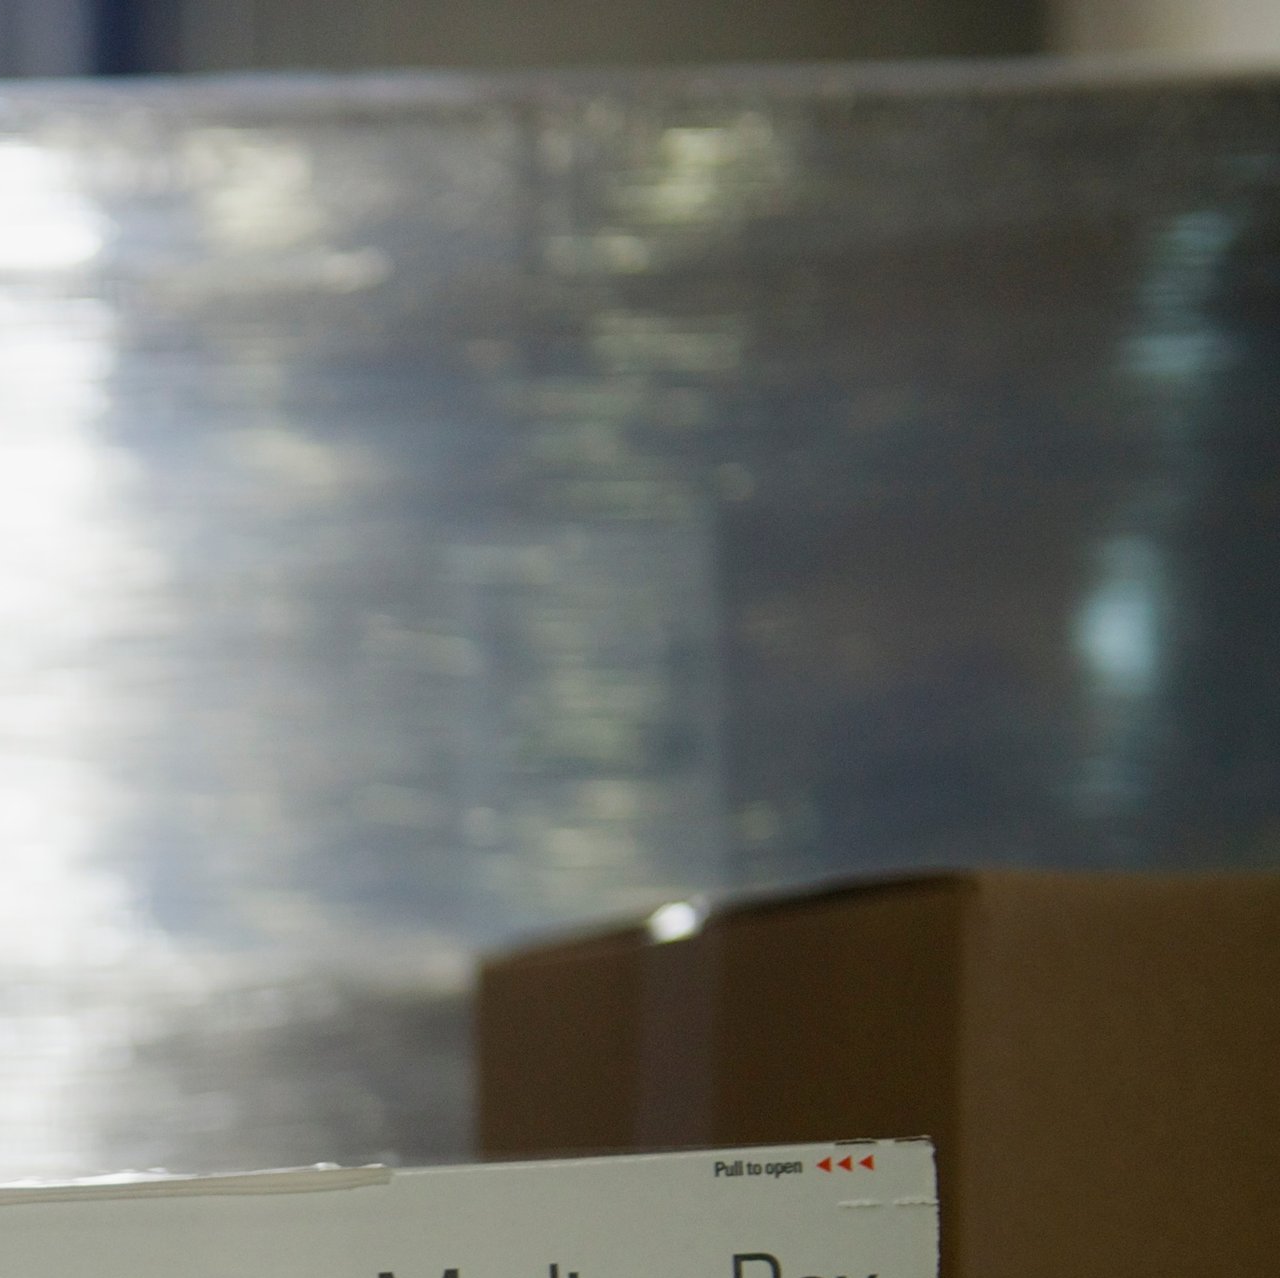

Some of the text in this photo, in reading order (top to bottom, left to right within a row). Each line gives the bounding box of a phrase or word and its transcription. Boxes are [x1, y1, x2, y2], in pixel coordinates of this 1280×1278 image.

[714, 1160, 803, 1179] Pull to open
